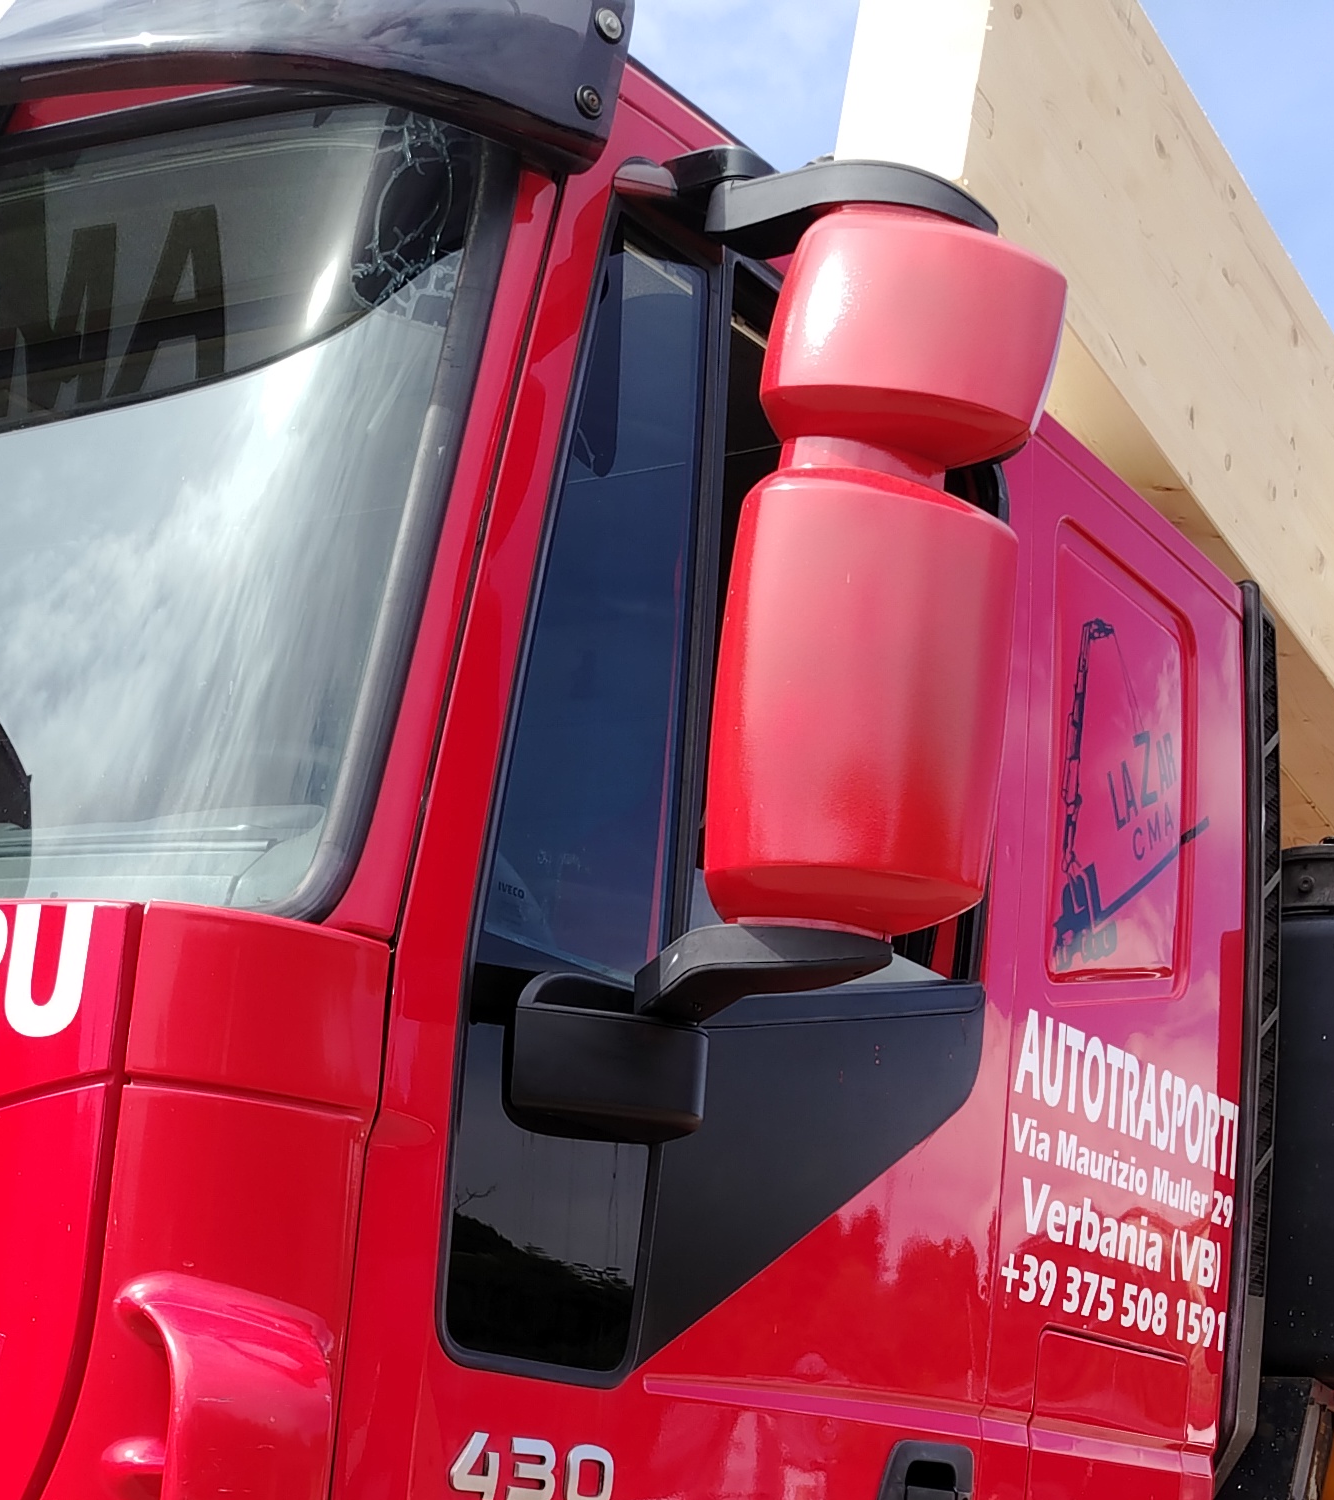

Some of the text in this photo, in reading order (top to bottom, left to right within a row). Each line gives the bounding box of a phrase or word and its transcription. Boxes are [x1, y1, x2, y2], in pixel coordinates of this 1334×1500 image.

[1107, 730, 1178, 831] LAZAR
[1132, 802, 1175, 861] CMA
[498, 881, 525, 900] IVECO
[1014, 1008, 1240, 1180] AUTOTRASPORTI
[1012, 1112, 1234, 1228] Via Maurizio Muller 29
[1022, 1176, 1222, 1294] Verbania (VB)
[1001, 1252, 1227, 1352] +39 375 508 1591
